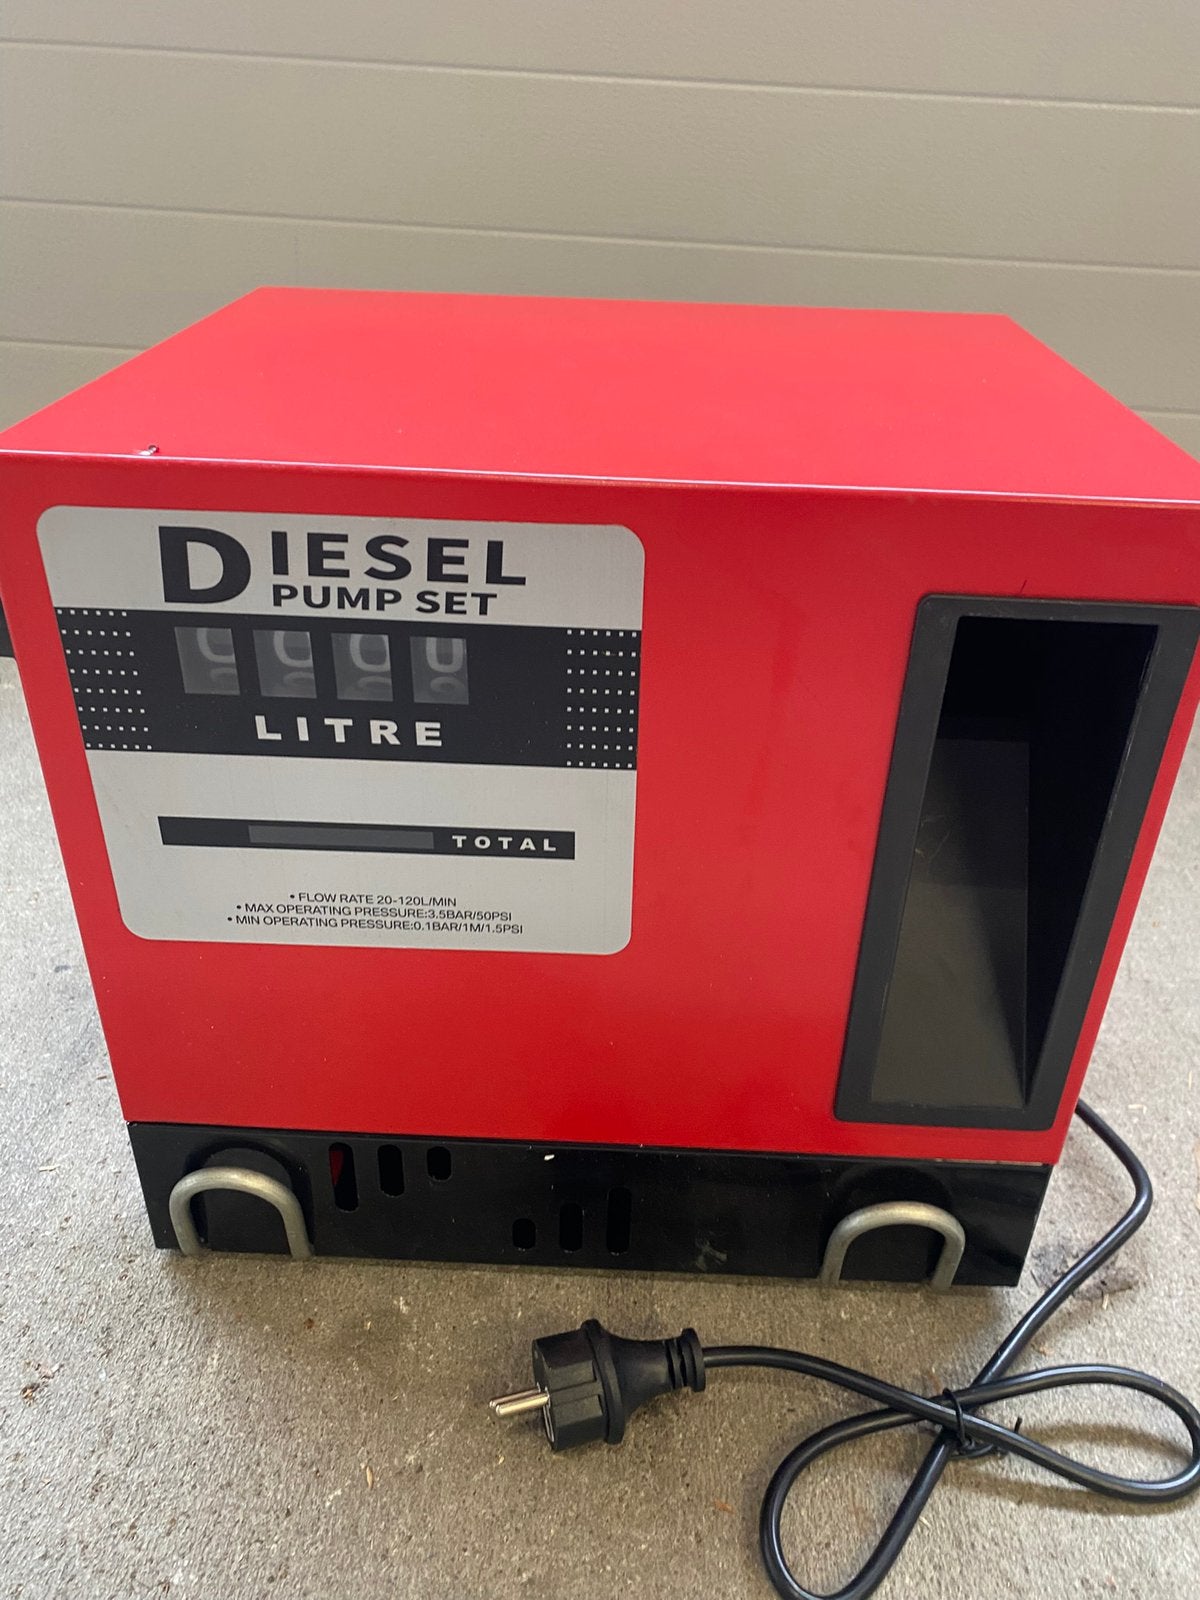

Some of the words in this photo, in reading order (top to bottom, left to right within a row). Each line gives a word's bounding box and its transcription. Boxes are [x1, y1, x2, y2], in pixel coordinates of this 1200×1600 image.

[158, 525, 526, 604] DIESEL
[272, 584, 402, 611] PUMP
[415, 590, 498, 616] SET
[254, 715, 443, 747] LITRE
[452, 835, 557, 852] TOTAL
[298, 892, 337, 903] FLOW
[339, 893, 374, 904] RATE
[376, 895, 457, 907] 20-120L/MIN
[244, 903, 274, 914] MAX
[276, 904, 352, 916] OPERATING
[354, 906, 512, 921] PRESSURE:3.5BAR/50PSI
[235, 915, 260, 925] MIN
[263, 916, 338, 928] OPERATING
[340, 918, 524, 934] PRESSURE:0.1BAR/1M/1.5PSI
